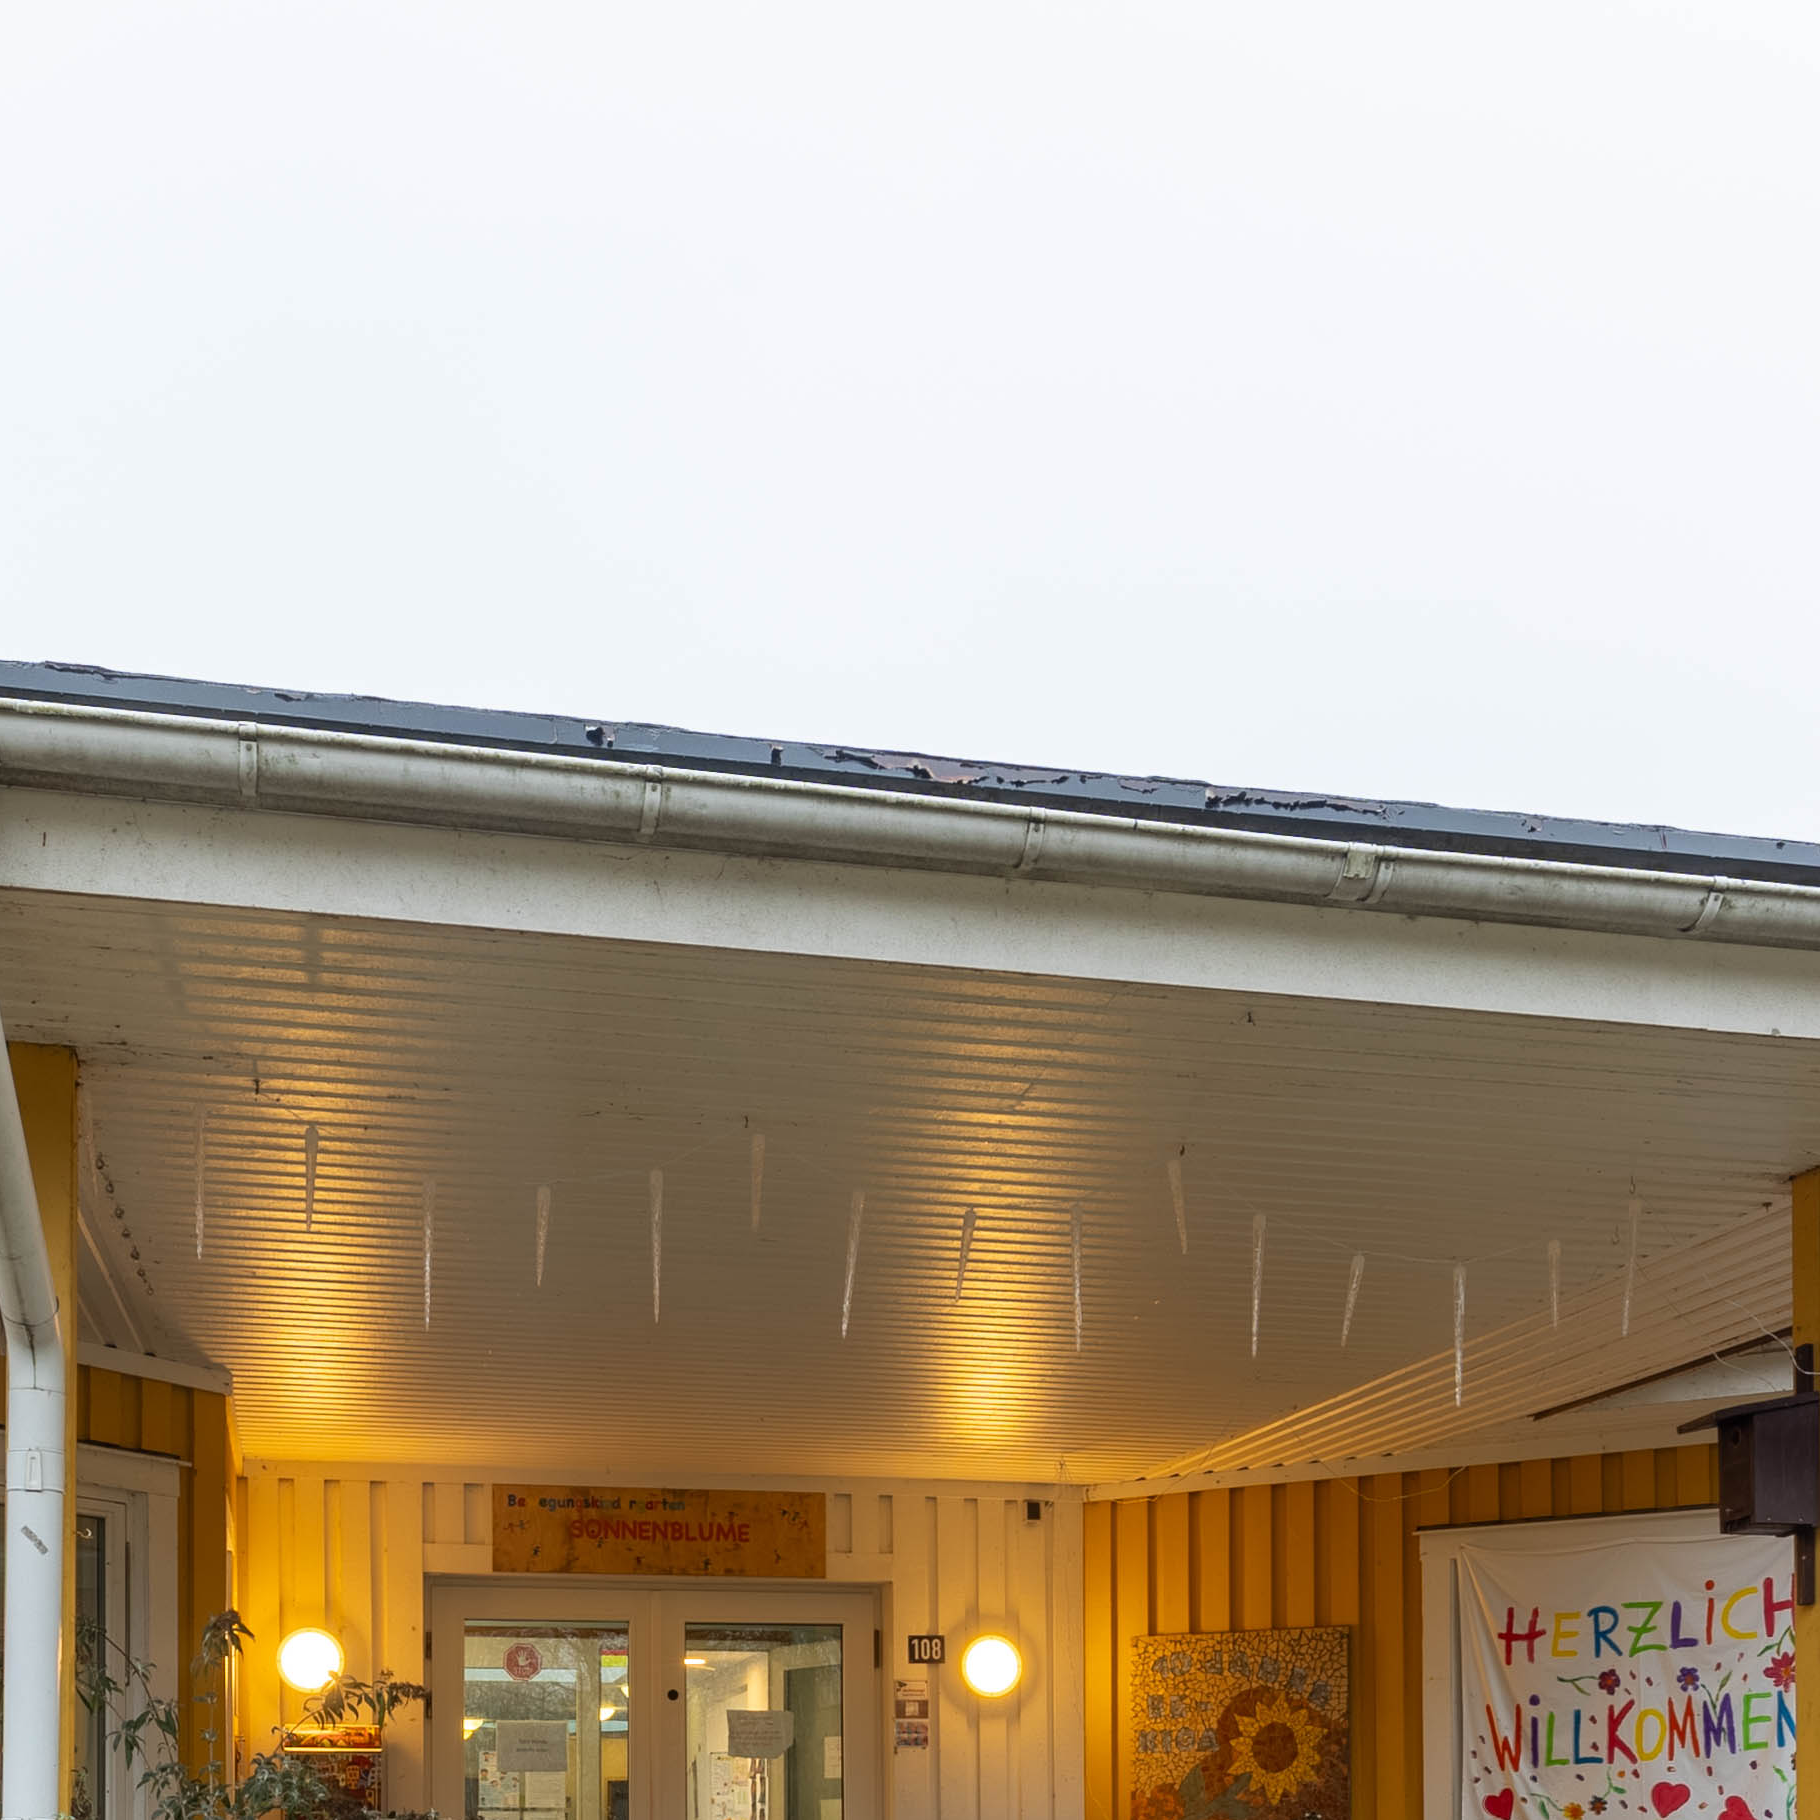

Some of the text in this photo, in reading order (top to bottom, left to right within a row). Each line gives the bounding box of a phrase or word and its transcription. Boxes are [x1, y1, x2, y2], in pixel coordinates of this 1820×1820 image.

[507, 1493, 686, 1513] Beegungskindrgarten
[571, 1518, 750, 1543] SONNENBLUME
[911, 1638, 942, 1660] 108
